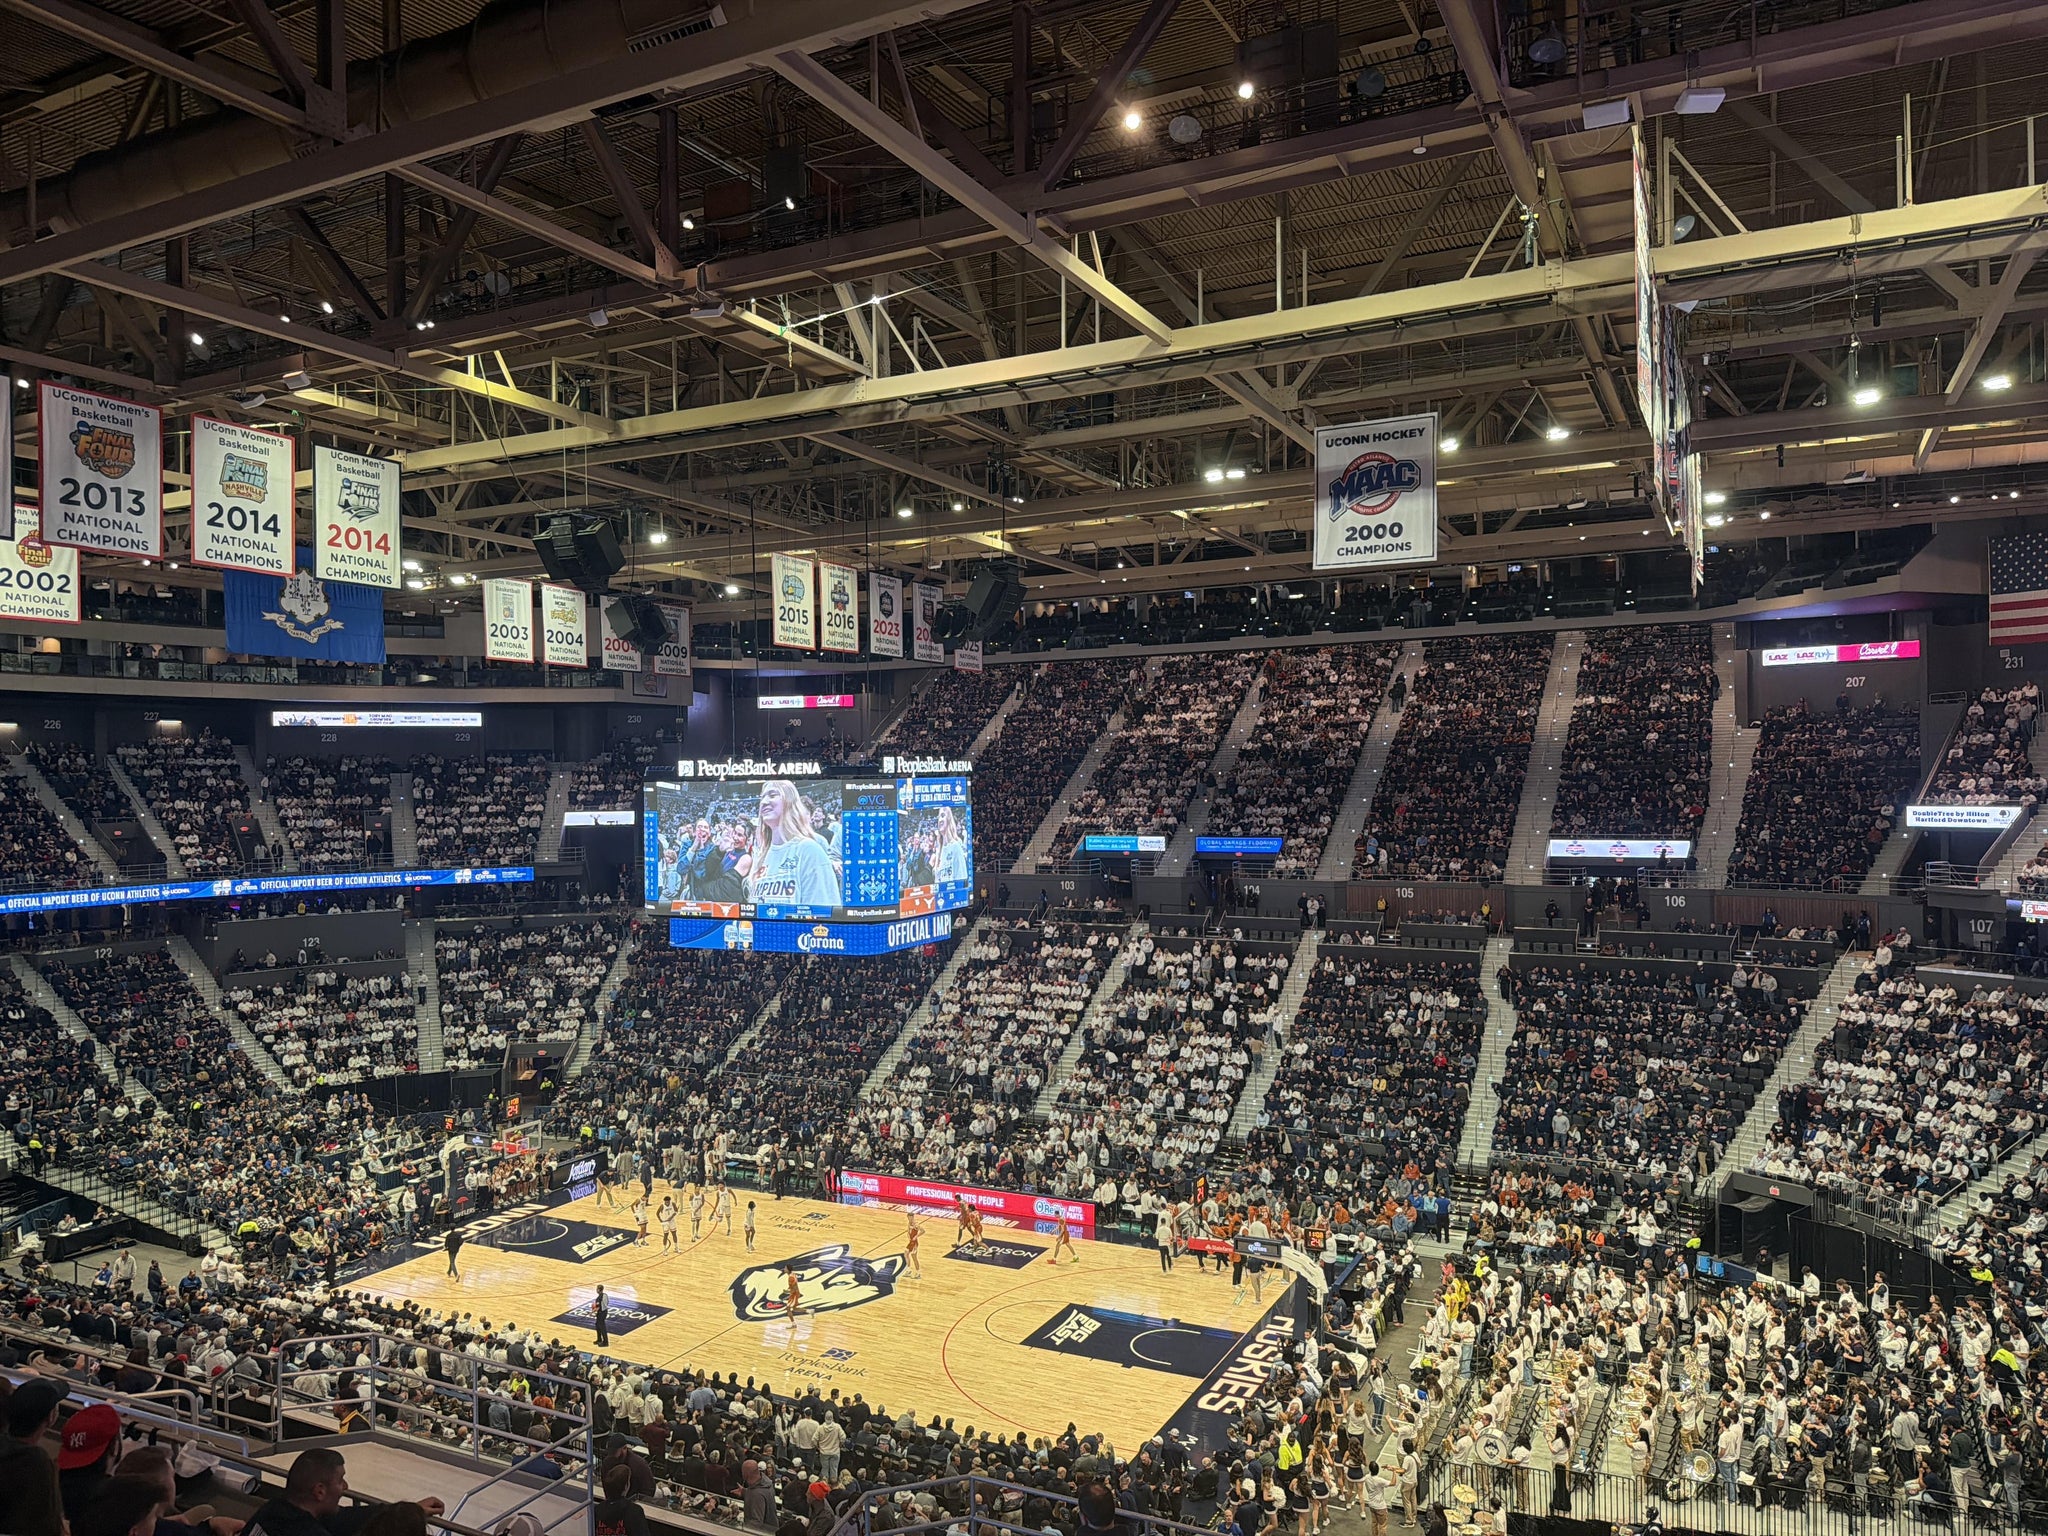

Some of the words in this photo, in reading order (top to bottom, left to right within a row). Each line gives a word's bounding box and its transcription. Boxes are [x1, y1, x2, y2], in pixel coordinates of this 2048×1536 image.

[52, 388, 93, 406] UConn
[96, 398, 150, 418] Women's
[71, 406, 133, 428] Basketball
[93, 428, 132, 449] FINAL
[202, 420, 237, 436] UConn
[240, 429, 284, 447] Women's
[1325, 434, 1370, 448] UCONN
[1372, 427, 1426, 442] HOCKEY
[218, 437, 270, 456] Basketball
[235, 459, 264, 475] FINAL
[330, 450, 360, 465] UConn
[361, 457, 385, 470] Men's
[336, 464, 380, 480] Basketball
[225, 482, 262, 497] NASHVILLE
[350, 482, 378, 498] FINAL
[1329, 460, 1420, 518] MAAC
[59, 477, 146, 517] 2013
[63, 511, 143, 534] NATIONAL
[206, 502, 281, 538] 2014
[56, 528, 149, 551] CHAMPIONS
[327, 523, 391, 555] 2014
[1345, 522, 1404, 542] 2000
[18, 544, 46, 556] Final
[211, 533, 277, 553] NATIONAL
[1336, 541, 1412, 556] CHAMPIONS
[205, 548, 283, 569] CHAMPIONS
[330, 552, 388, 570] NATIONAL
[0, 567, 71, 594] 2002
[325, 566, 392, 584] CHAMPIONS
[5, 592, 65, 606] NATIONAL
[0, 604, 70, 618] CHAMPIONS
[779, 605, 808, 625] 2015
[826, 611, 855, 630] 2016
[873, 619, 900, 637] 2023
[490, 623, 529, 640] 2003
[781, 625, 808, 635] NATIONAL
[828, 630, 854, 640] NATIONAL
[494, 641, 526, 650] NATIONAL
[546, 629, 584, 647] 2004
[779, 635, 811, 645] CHAMPIONS
[826, 639, 856, 649] CHAMPIONS
[875, 637, 898, 646] NATIONAL
[492, 649, 529, 658] CHAMPIONS
[550, 647, 580, 656] NATIONAL
[874, 646, 900, 655] CHAMPIONS
[918, 644, 939, 652] NATIONAL
[548, 654, 583, 664] CHAMPIONS
[608, 653, 635, 661] NATIONAL
[660, 659, 685, 667] NATIONAL
[917, 652, 942, 661] CHAMPIONS
[958, 660, 980, 668] CHAMPIONS
[2004, 657, 2024, 669] 231
[658, 666, 687, 674] CHAMPIONS
[1845, 676, 1866, 687] 207
[144, 712, 159, 721] 227
[627, 715, 642, 724] 230
[44, 719, 61, 730] 226
[321, 733, 337, 742] 228
[455, 733, 471, 742] 229
[697, 757, 777, 781] PeoplesBank
[778, 762, 821, 775] ARENA
[896, 756, 948, 778] PeoplesBank
[948, 760, 973, 772] ARENA
[261, 880, 289, 889] OFFICIAL
[290, 878, 315, 888] IMPORT
[317, 877, 333, 886] BEER
[335, 877, 343, 885] OF
[345, 876, 367, 885] UCONN
[369, 875, 401, 884] ATHLETICS
[1060, 880, 1075, 890] 103
[8, 897, 40, 909] OFFICIAL
[42, 895, 70, 906] IMPORT
[71, 893, 89, 904] BEER
[91, 892, 100, 902] OF
[102, 891, 125, 901] UCONN
[126, 888, 160, 899] ATHLETICS
[1395, 887, 1414, 899] 105
[1664, 895, 1686, 907] 106
[2022, 904, 2034, 914] 16
[888, 918, 931, 947] OFFICIAL
[1968, 919, 1994, 933] 107
[302, 937, 320, 947] 123
[797, 932, 845, 953] Corona
[94, 947, 113, 959] 122
[507, 1106, 518, 1117] 24
[906, 1185, 954, 1200] PROFESSIONAL
[978, 1195, 1005, 1208] PEOPLE
[1066, 1212, 1084, 1221] PARTS
[1068, 1205, 1082, 1214] AUTO
[1310, 1237, 1321, 1246] 24
[1050, 1312, 1090, 1346] EAST
[1070, 1318, 1103, 1344] BIG
[1196, 1315, 1295, 1415] HUSKIES
[784, 1366, 833, 1381] ARENA
